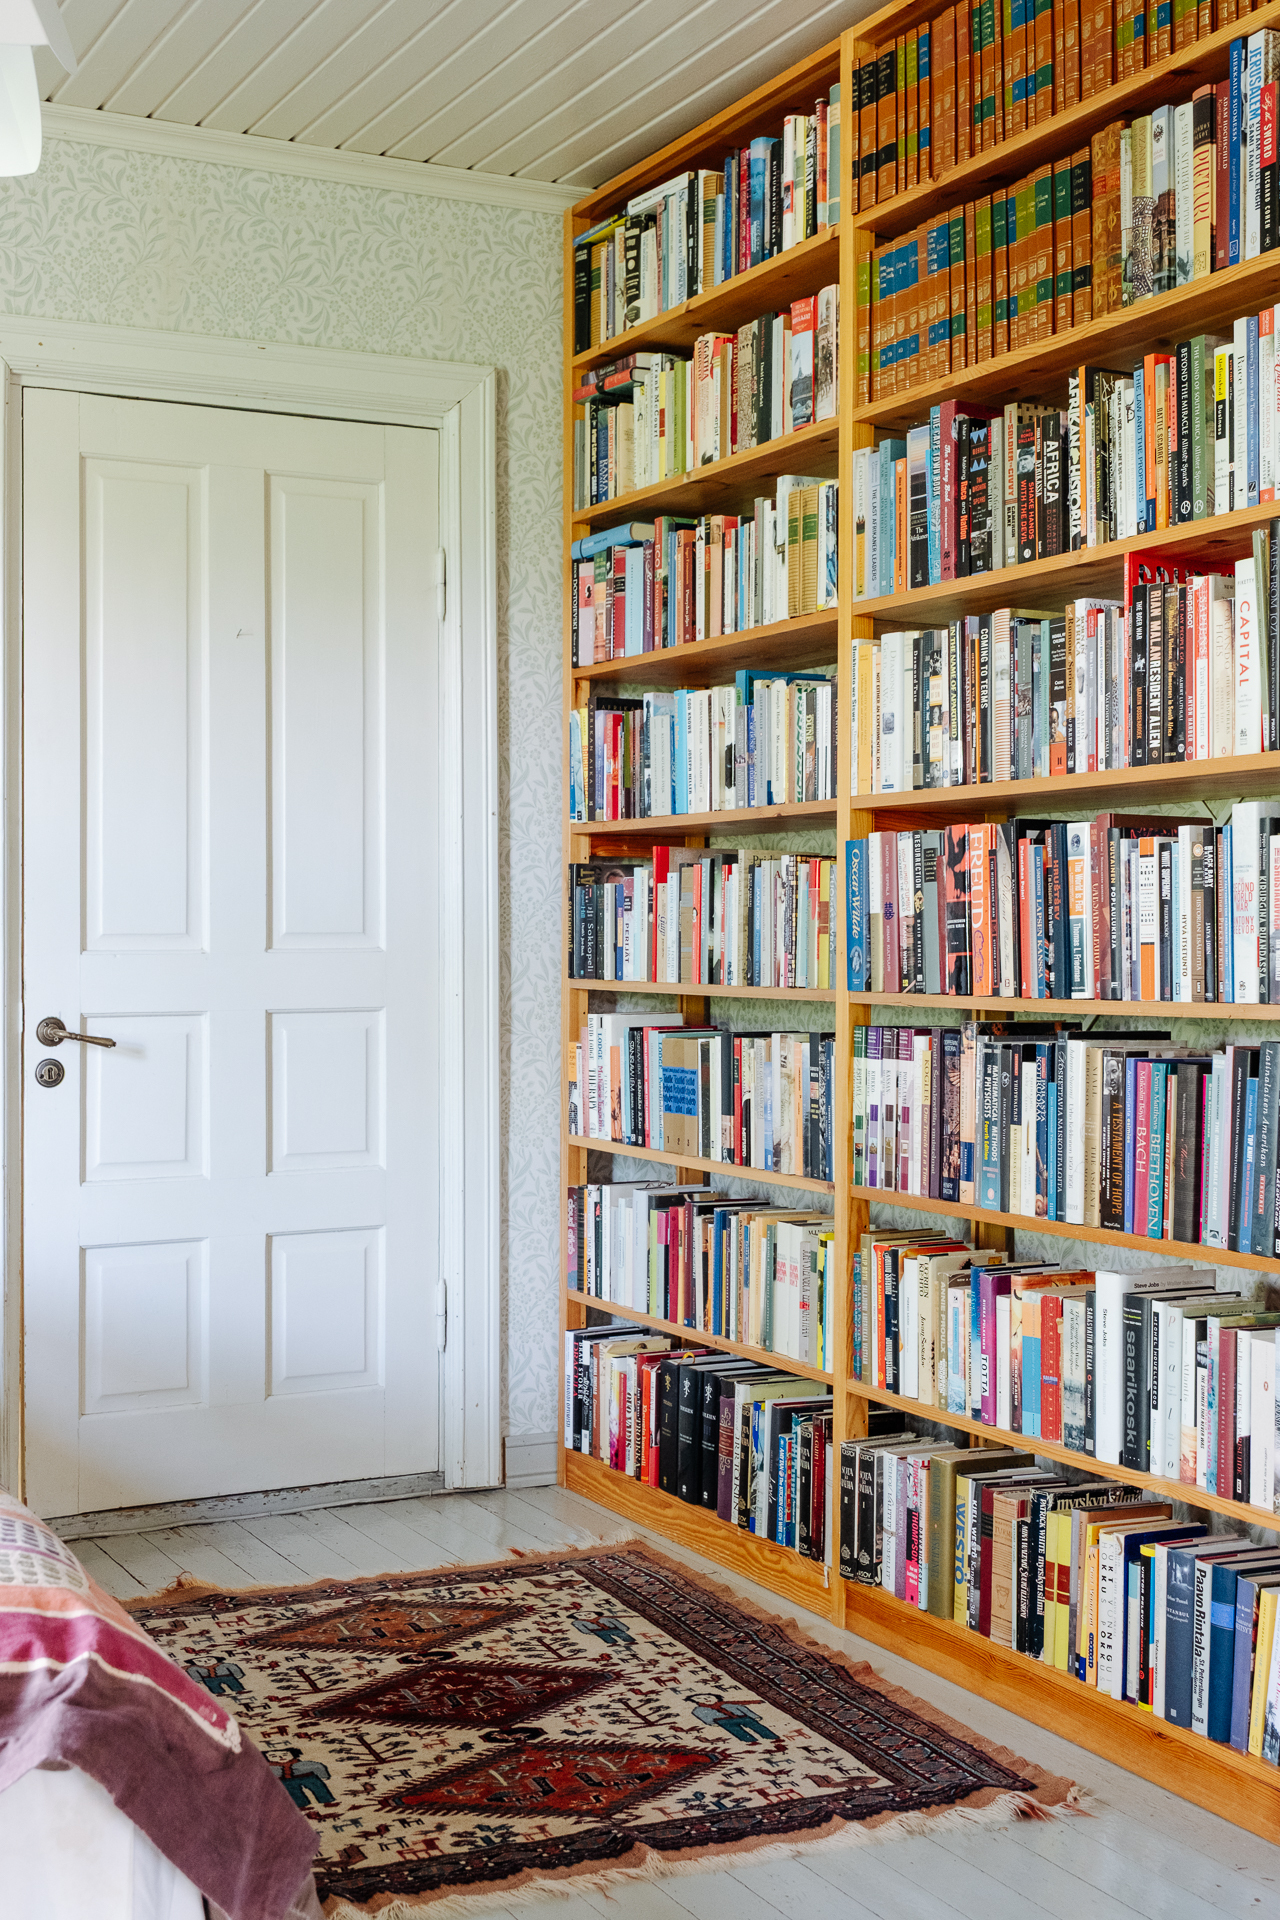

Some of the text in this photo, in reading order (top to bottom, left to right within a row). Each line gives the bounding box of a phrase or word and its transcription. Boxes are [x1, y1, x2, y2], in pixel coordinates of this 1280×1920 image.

[1248, 46, 1261, 121] JERUSALEM
[1181, 123, 1189, 147] 1945
[1264, 108, 1272, 122] the
[806, 135, 814, 156] THE
[1138, 125, 1147, 190] BYZANTIUM
[1263, 123, 1272, 158] SWORD
[1181, 151, 1189, 191] BERLIN
[1194, 380, 1200, 391] OF
[932, 414, 940, 429] THE
[1181, 400, 1189, 435] MIRACLE
[1234, 355, 1245, 471] Race Ryland Fisher
[1069, 376, 1081, 537] AFRIKAN HISTORIA
[1181, 438, 1189, 461] Allister
[960, 480, 968, 500] Race
[1046, 441, 1059, 504] AFRICA
[1180, 463, 1189, 487] Sparks
[1193, 471, 1202, 494] Sparks
[960, 515, 968, 540] Nation
[653, 544, 661, 568] ECO
[1150, 620, 1161, 660] MALAN
[1239, 600, 1250, 687] CAPITAL
[980, 628, 988, 709] COMING TO TERMS
[970, 830, 984, 928] FREUD
[1075, 862, 1084, 874] The
[1075, 875, 1083, 891] World
[850, 848, 861, 939] Oscar Wilde
[1075, 900, 1083, 912] Flat
[1259, 875, 1267, 923] KIRURGINA
[586, 923, 594, 972] Sokkopeli
[1262, 1049, 1273, 1114] Latinalaisen
[1112, 1112, 1122, 1170] TESTAMENT
[1136, 1127, 1146, 1172] BACH
[1260, 1116, 1270, 1167] Amerikan
[1112, 1172, 1122, 1185] OF
[1148, 1134, 1161, 1230] BEETHOVEN
[1112, 1188, 1122, 1215] HOPE
[1126, 1330, 1138, 1448] saarikoski
[1039, 1499, 1047, 1528] PATRICK
[911, 1511, 919, 1564] THOMPSON
[955, 1503, 967, 1585] WESTÖ
[1036, 1556, 1046, 1616] myrskynsilmä
[1195, 1568, 1207, 1608] Paavo
[1194, 1609, 1206, 1657] Rintala
